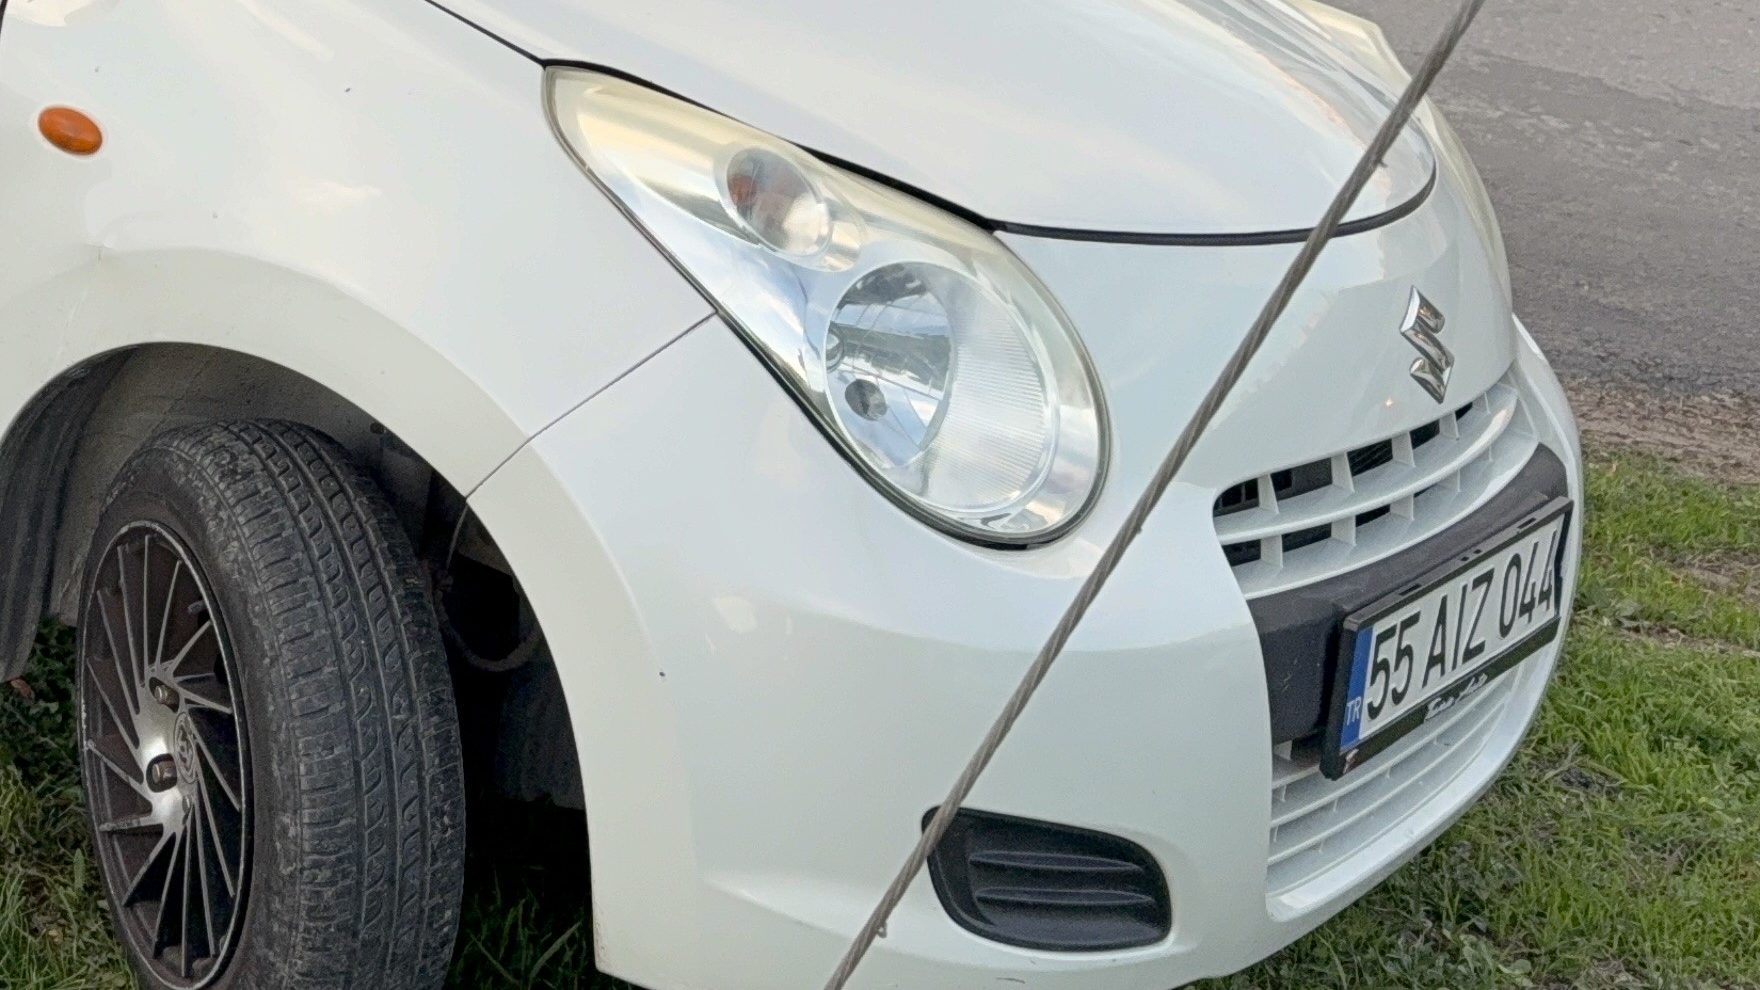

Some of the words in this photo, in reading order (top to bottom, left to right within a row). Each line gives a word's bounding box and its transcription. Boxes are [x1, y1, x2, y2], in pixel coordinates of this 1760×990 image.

[1367, 610, 1422, 721] 55
[1421, 567, 1495, 690] AIZ
[1499, 529, 1558, 640] 044
[1345, 696, 1363, 727] TR
